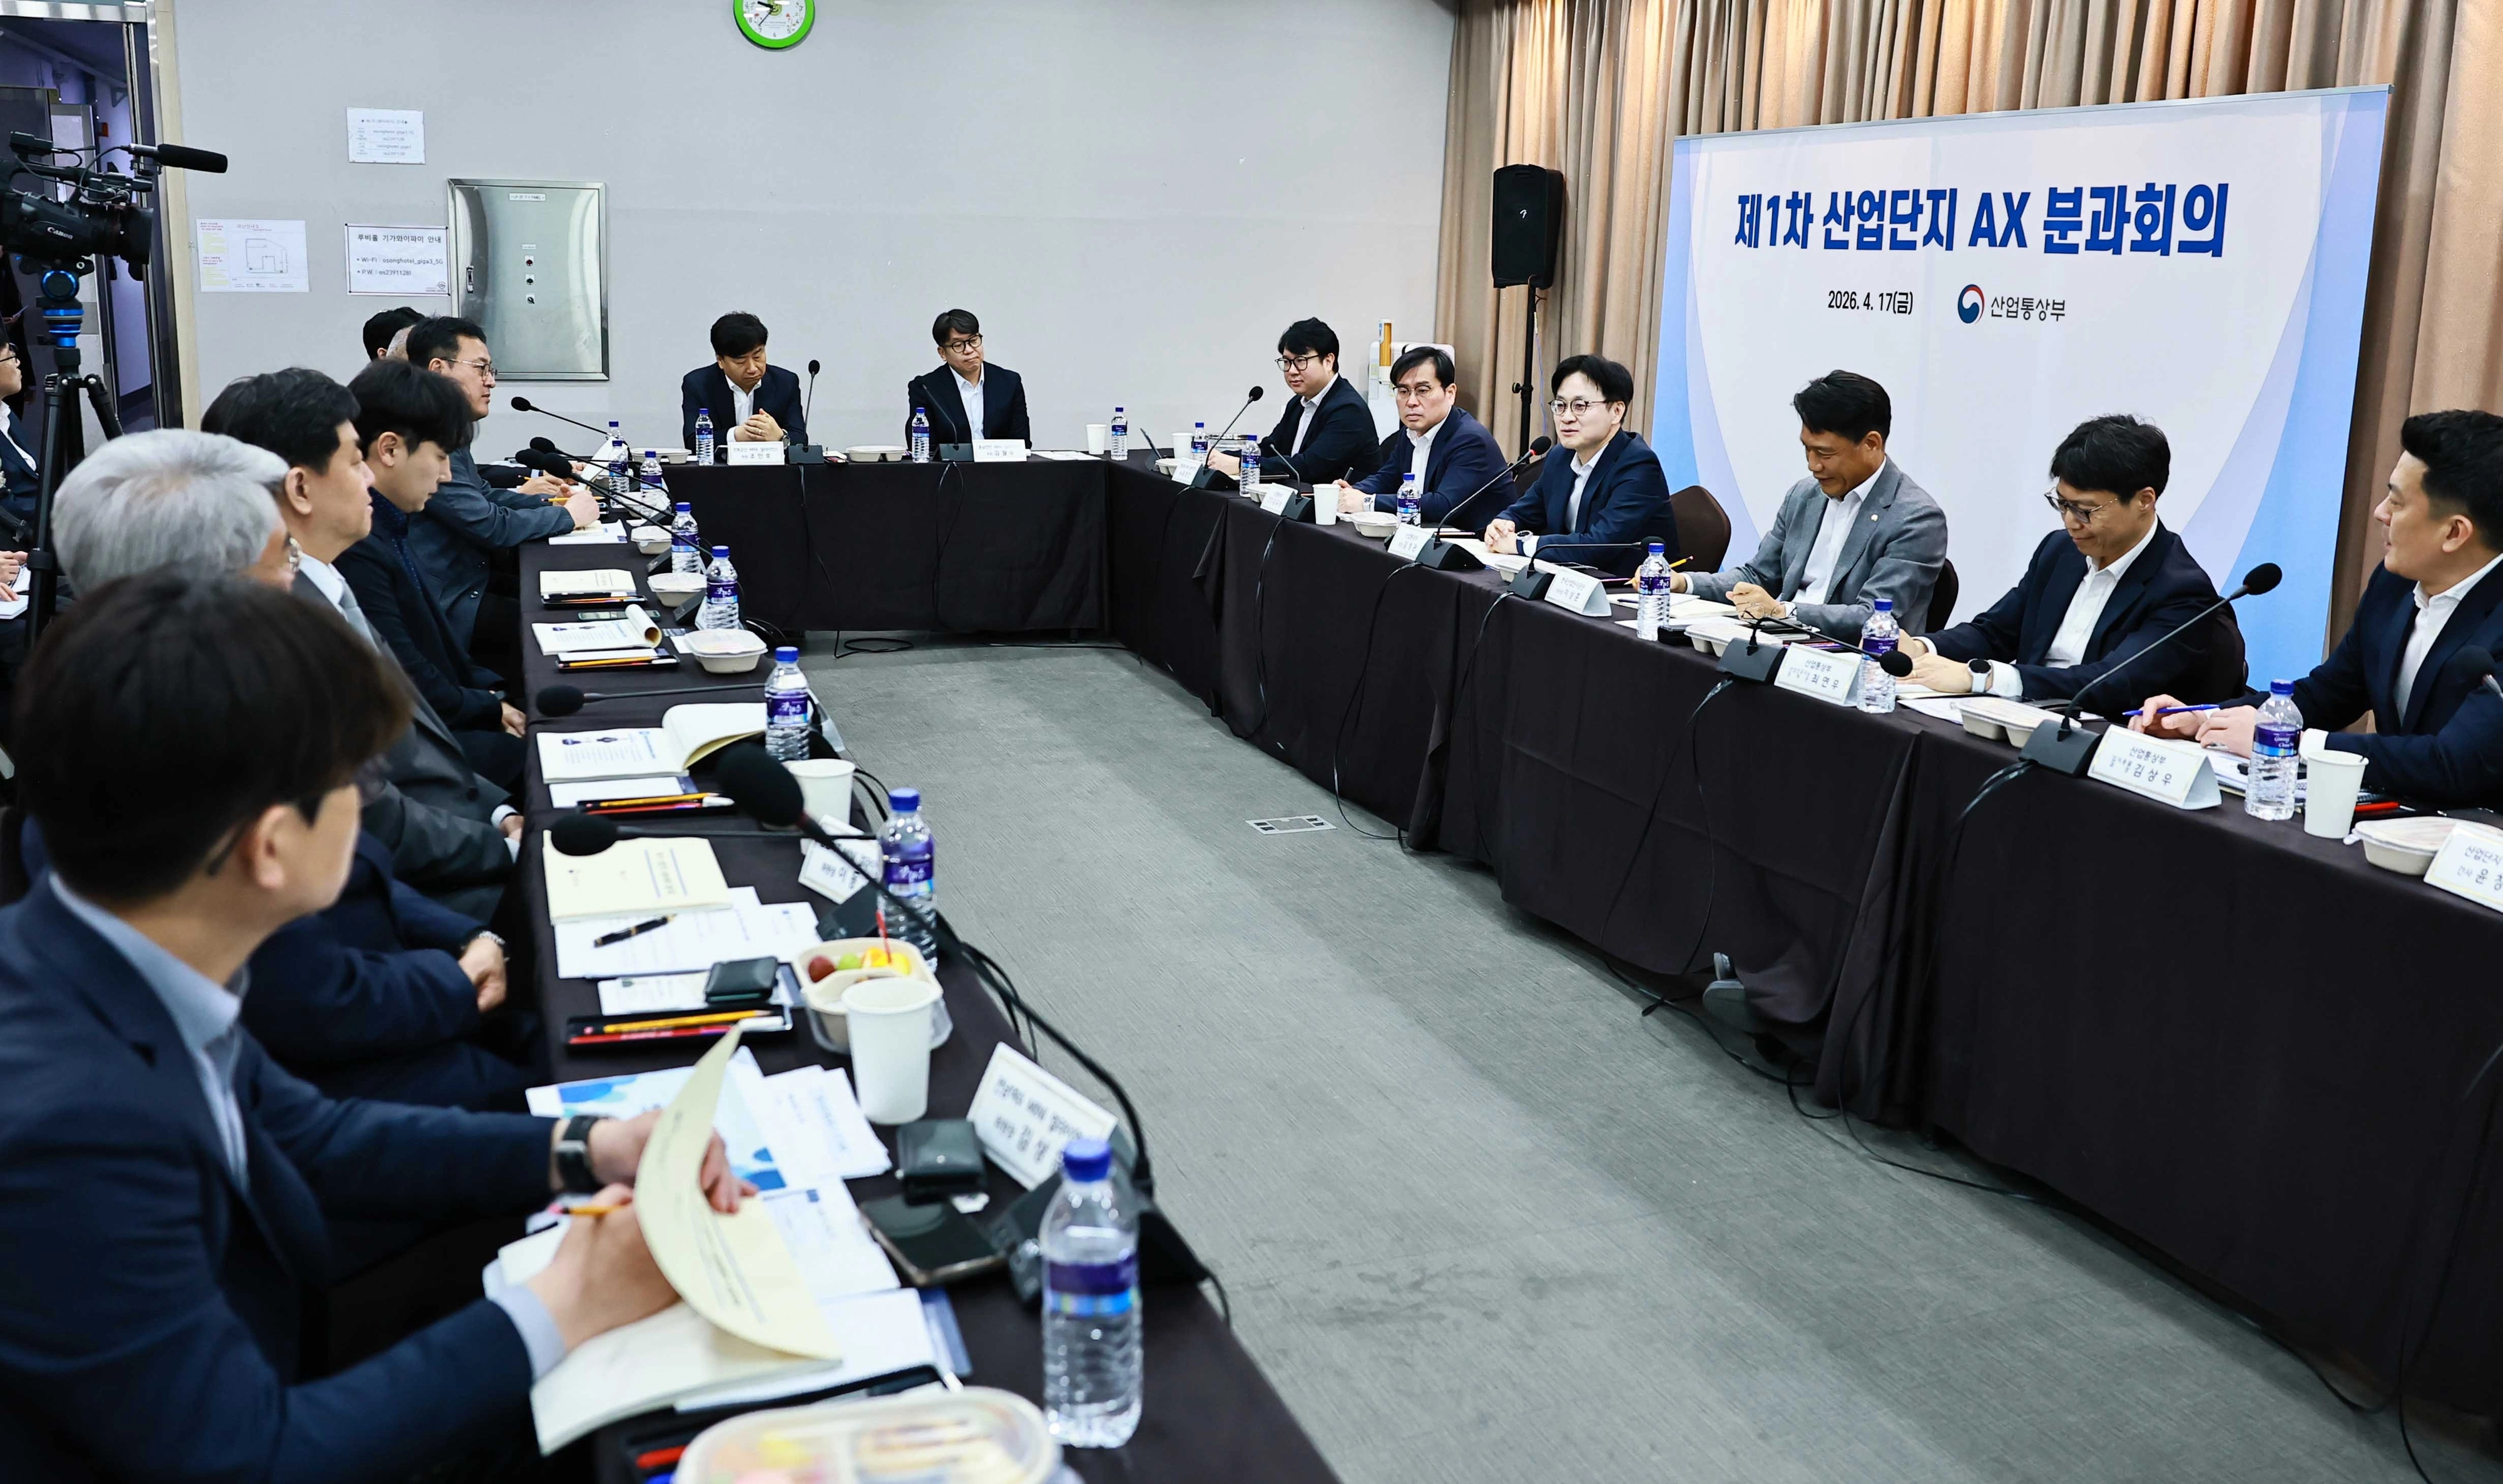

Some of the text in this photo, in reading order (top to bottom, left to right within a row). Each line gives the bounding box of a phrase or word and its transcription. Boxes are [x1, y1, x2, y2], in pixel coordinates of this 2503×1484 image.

[1735, 182, 2230, 258] 제1차 산업단지 AX 분과회의
[47, 226, 73, 240] Canon
[382, 235, 424, 243] 기가와이파이
[1828, 290, 1914, 315] 2026. 4. 17(금)
[1991, 296, 2066, 322] 산업통상부
[1805, 659, 1832, 673] 산업통상부
[2129, 746, 2167, 766] 산업통상부
[2133, 763, 2173, 786] 김상우
[2464, 845, 2503, 866] 산업단지
